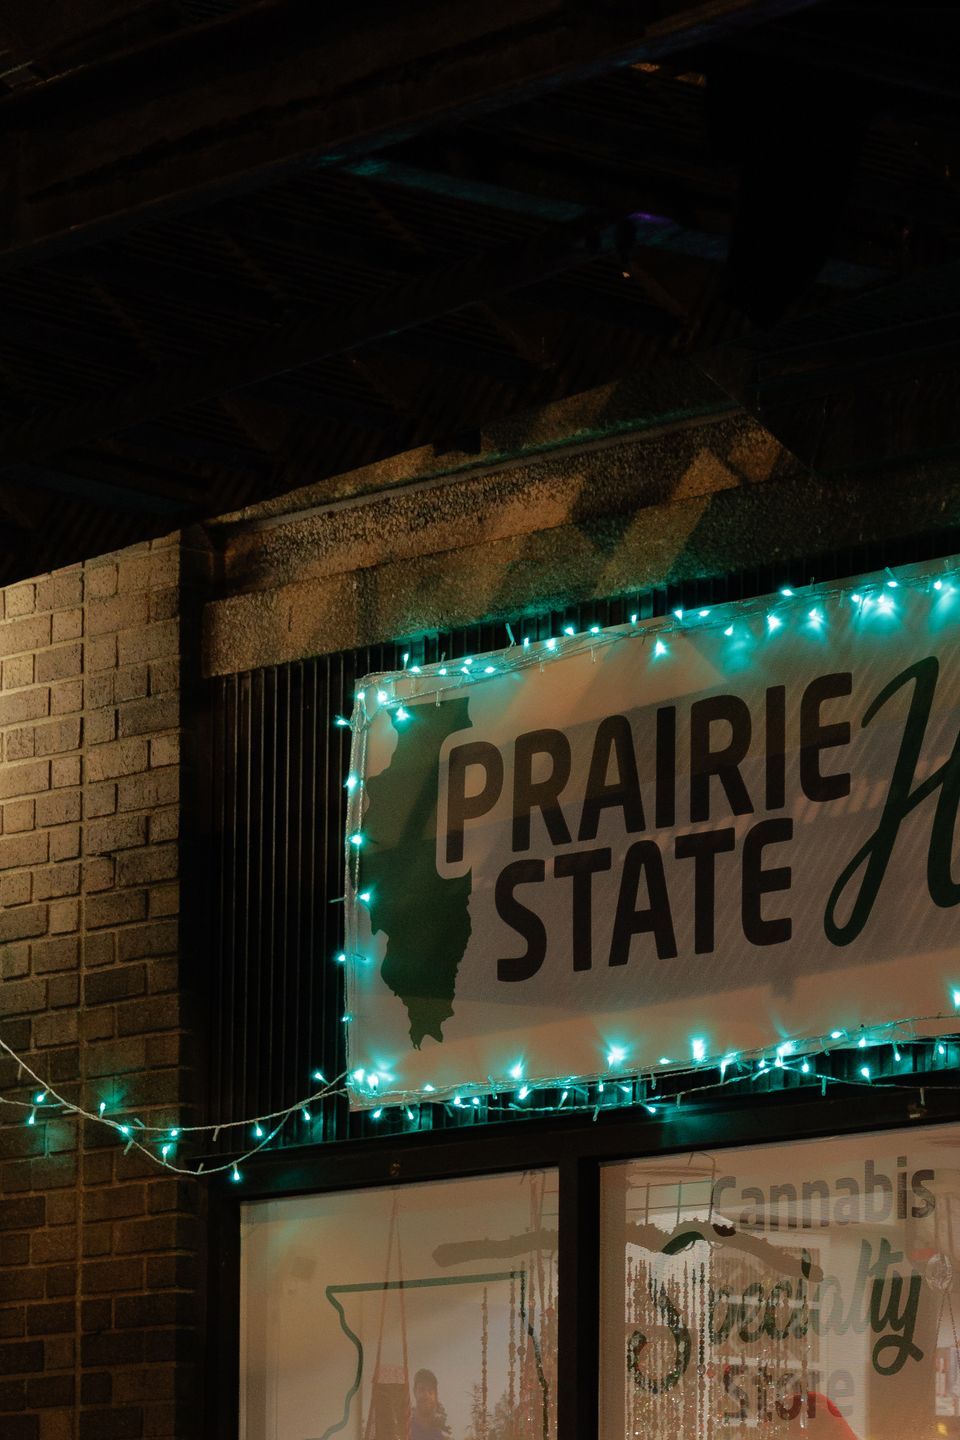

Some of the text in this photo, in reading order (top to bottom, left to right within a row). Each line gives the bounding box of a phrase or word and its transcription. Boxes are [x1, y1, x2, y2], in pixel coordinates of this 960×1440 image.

[446, 672, 853, 864] PRAIRIE
[496, 817, 795, 983] STATE
[713, 1155, 936, 1233] Cannabis
[723, 1365, 855, 1425] Store
